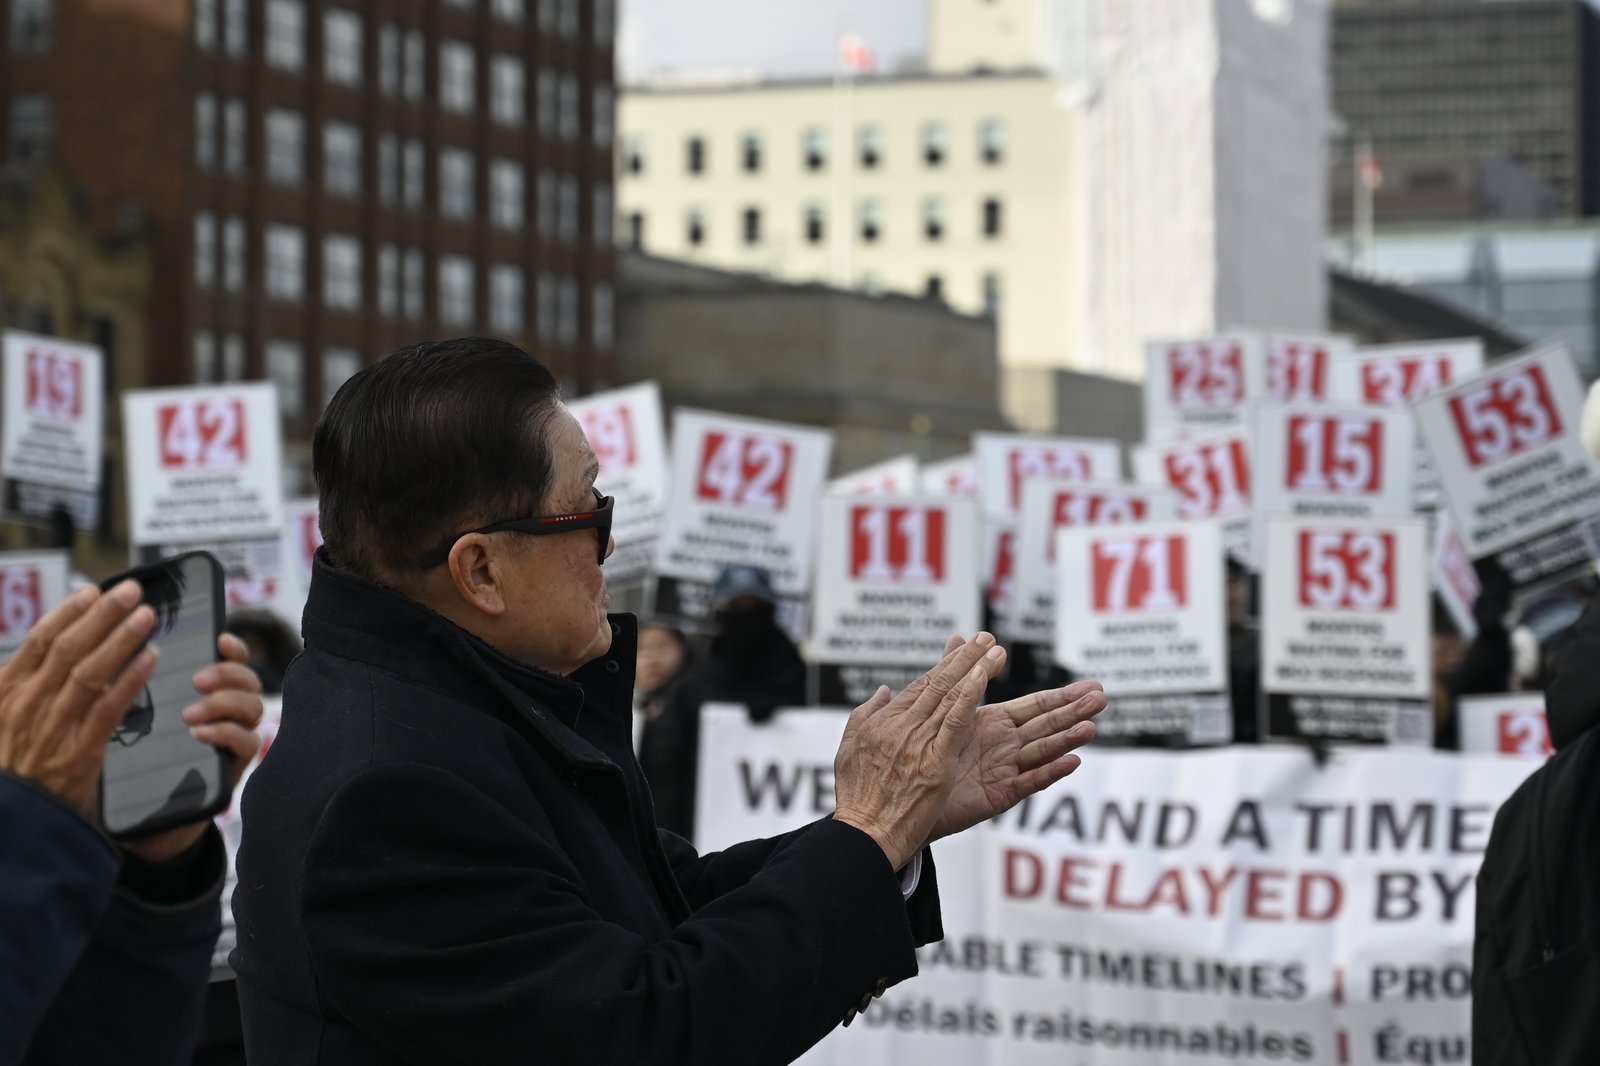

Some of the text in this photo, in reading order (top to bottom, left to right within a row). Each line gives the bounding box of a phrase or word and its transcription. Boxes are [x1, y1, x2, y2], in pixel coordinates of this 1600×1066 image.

[1176, 346, 1239, 404] 25
[163, 401, 246, 466] 42
[1298, 418, 1373, 493] 15
[1467, 371, 1553, 466] 53
[702, 432, 790, 508] 42
[1170, 443, 1243, 516] 31
[858, 507, 936, 582] 11
[1100, 537, 1177, 611] 71
[1306, 532, 1389, 608] 53
[738, 759, 835, 813] WE
[1220, 799, 1270, 852] A
[1296, 801, 1490, 855] TIME
[1001, 848, 1473, 923] DELAYED BY
[918, 936, 1045, 977] ABLE
[1058, 942, 1308, 1000] TIMELINES
[1371, 966, 1472, 1001] PRO
[863, 996, 1000, 1034] Délais
[1012, 1010, 1314, 1061] raisonnables
[1375, 1020, 1466, 1066] Équ
